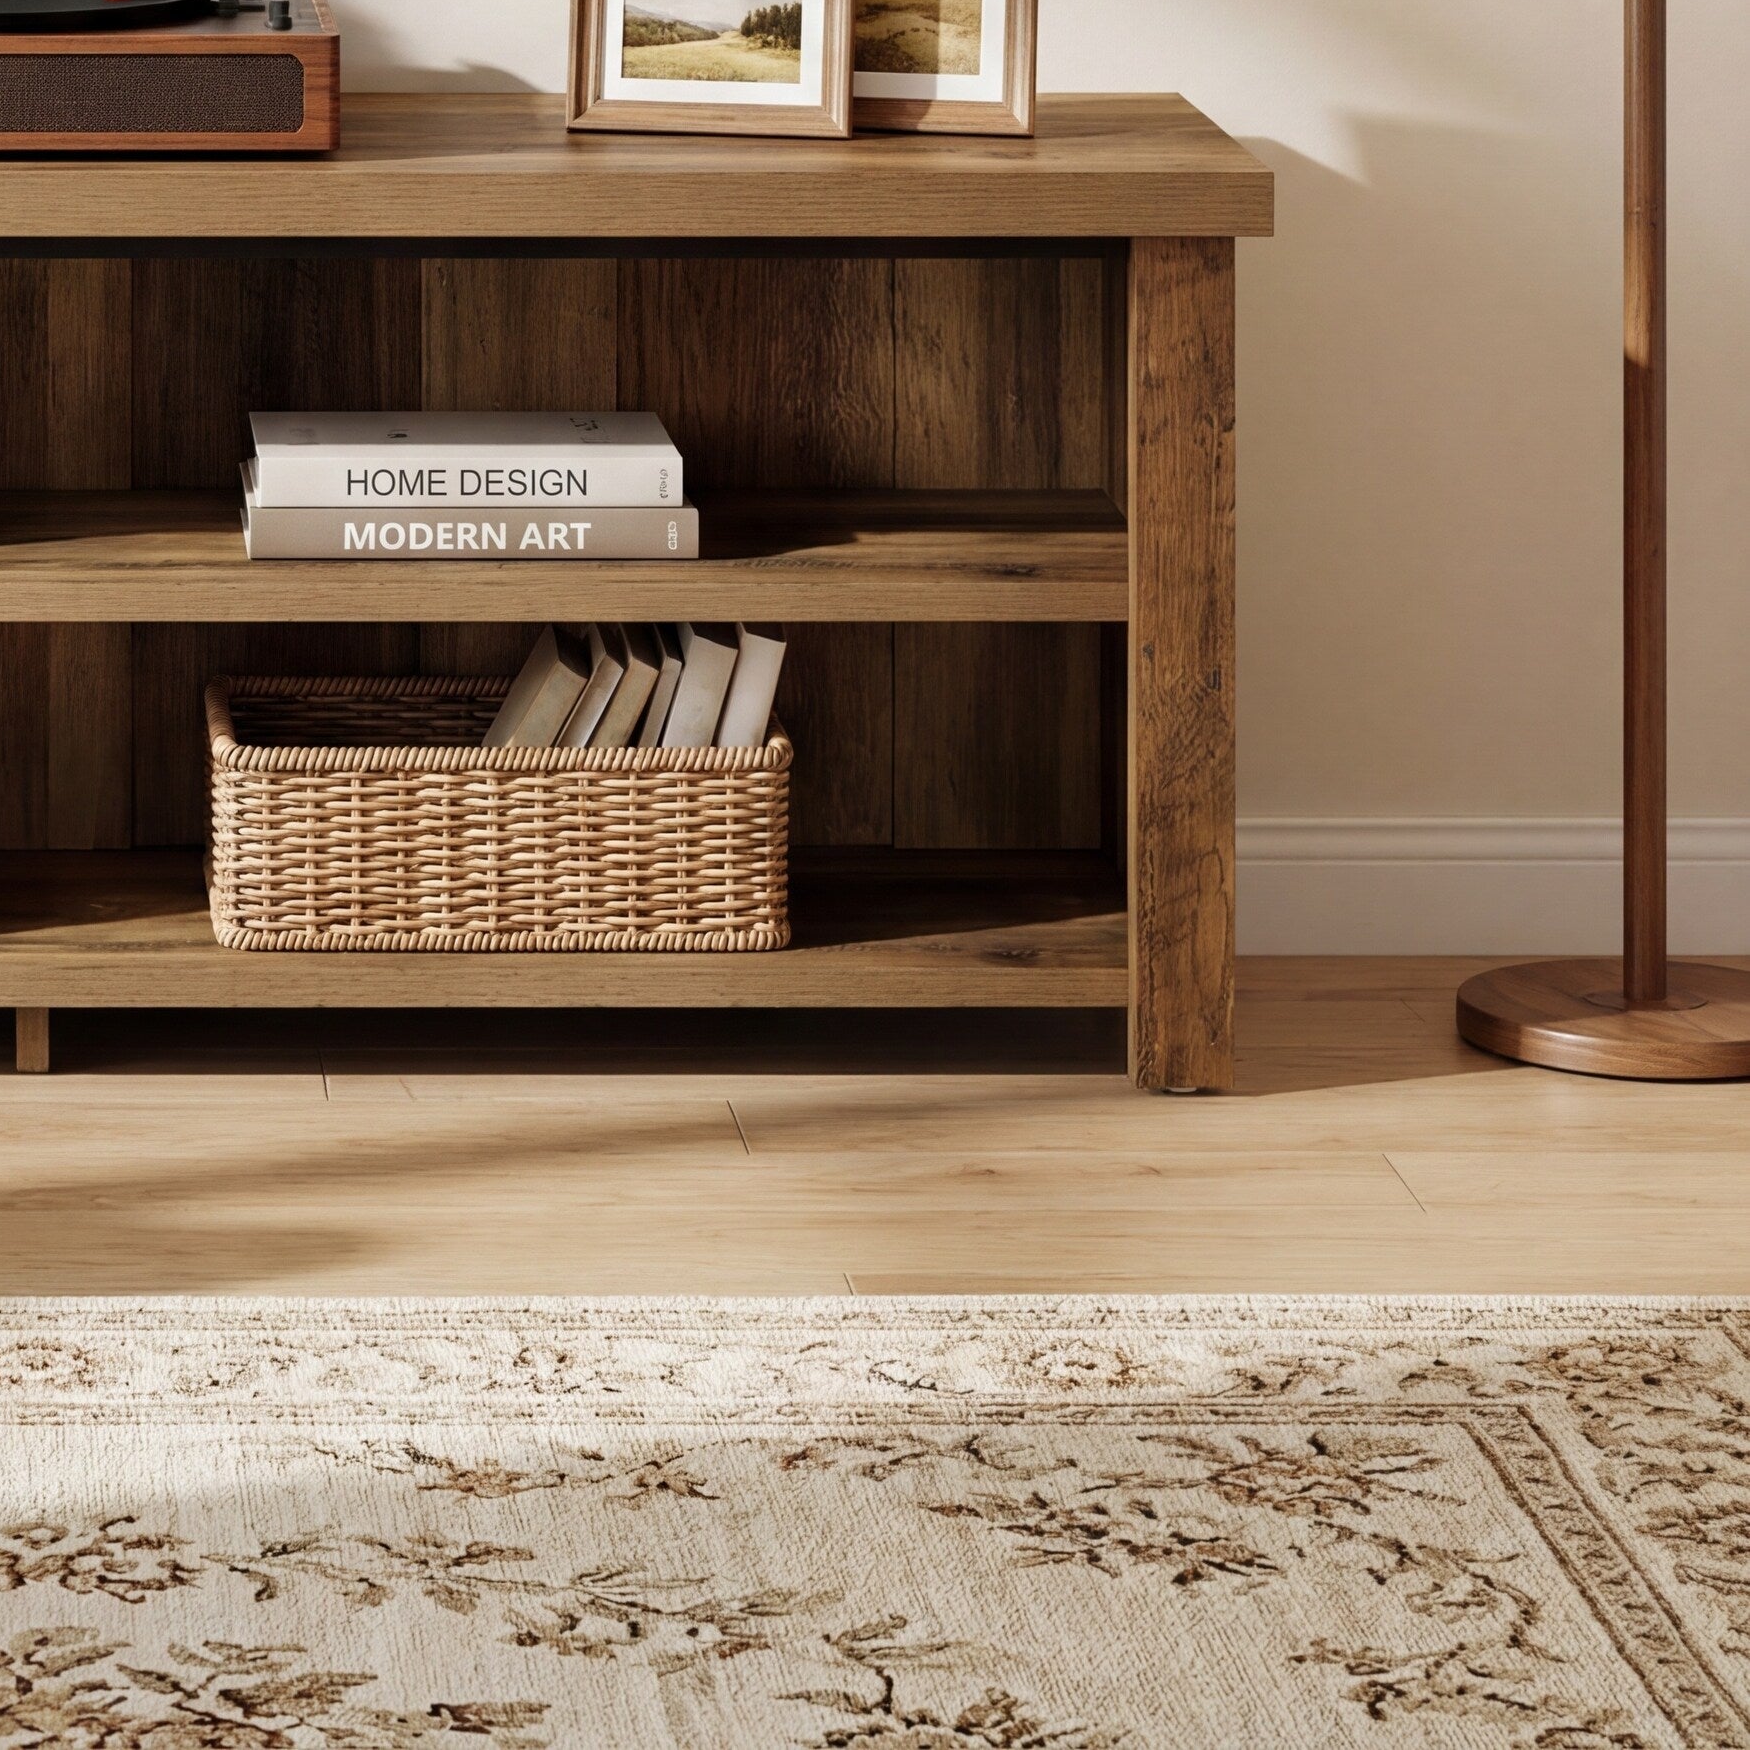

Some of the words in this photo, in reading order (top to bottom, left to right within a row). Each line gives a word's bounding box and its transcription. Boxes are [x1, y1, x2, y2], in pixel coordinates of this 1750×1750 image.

[347, 469, 448, 496] HOME
[460, 469, 588, 496] DESIGN
[344, 522, 507, 550] MODERN
[519, 522, 592, 550] ART
